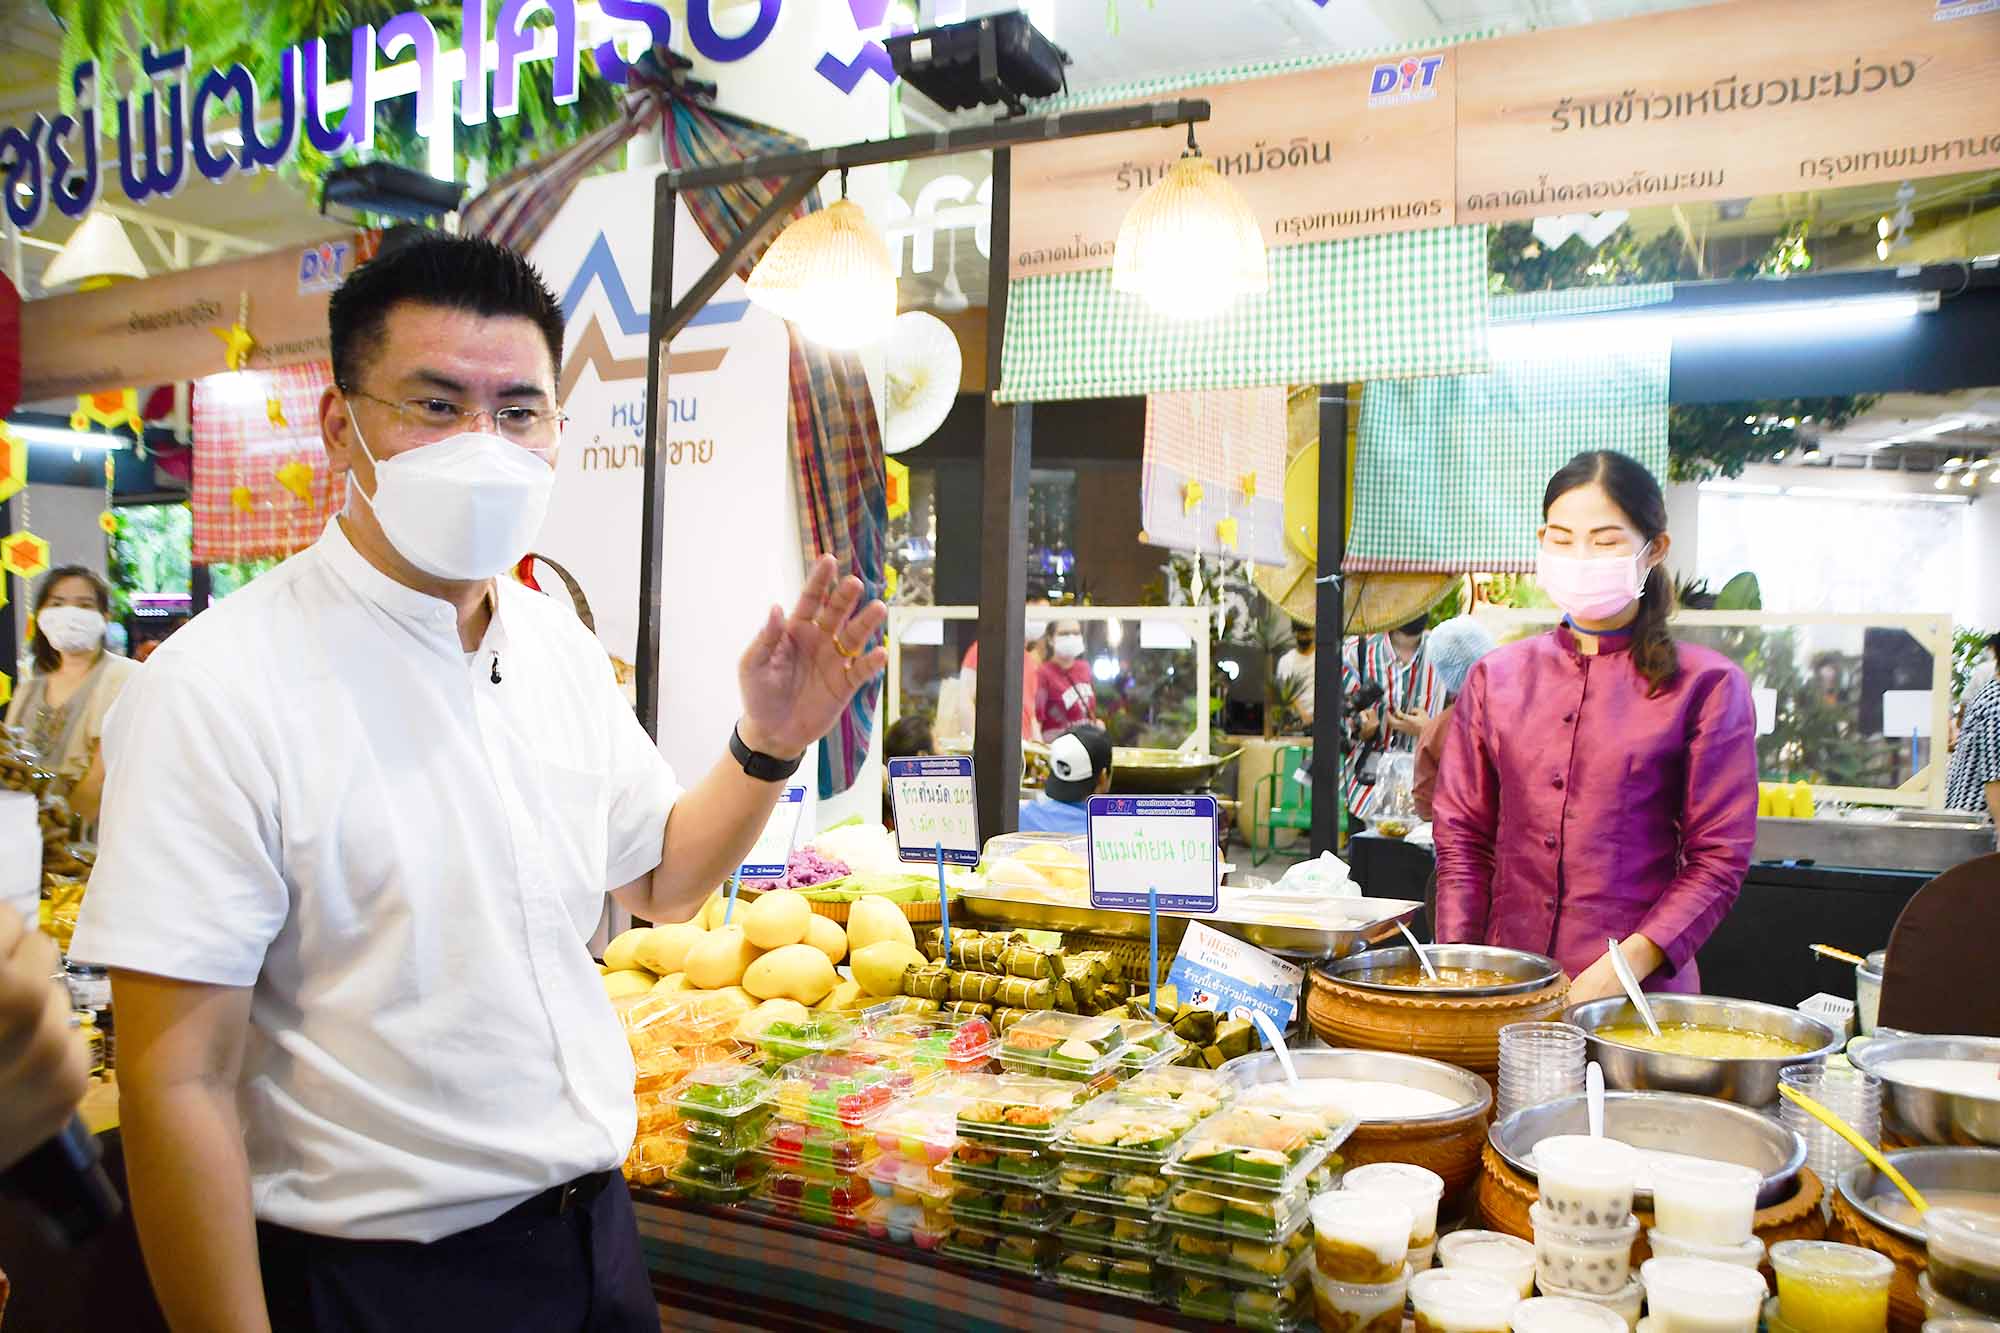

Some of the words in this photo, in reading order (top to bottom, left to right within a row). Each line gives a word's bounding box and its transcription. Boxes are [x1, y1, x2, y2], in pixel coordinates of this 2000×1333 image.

[1551, 57, 1916, 133] ร้านข้าวเหนียวมะม่วง
[1467, 167, 1725, 211] ตลาดน้ำคลองลัดมะยม
[1275, 200, 1442, 237] กรุงเทพมหานคร
[611, 388, 698, 437] หมู่าน
[1096, 828, 1175, 861] ขนมเทียน
